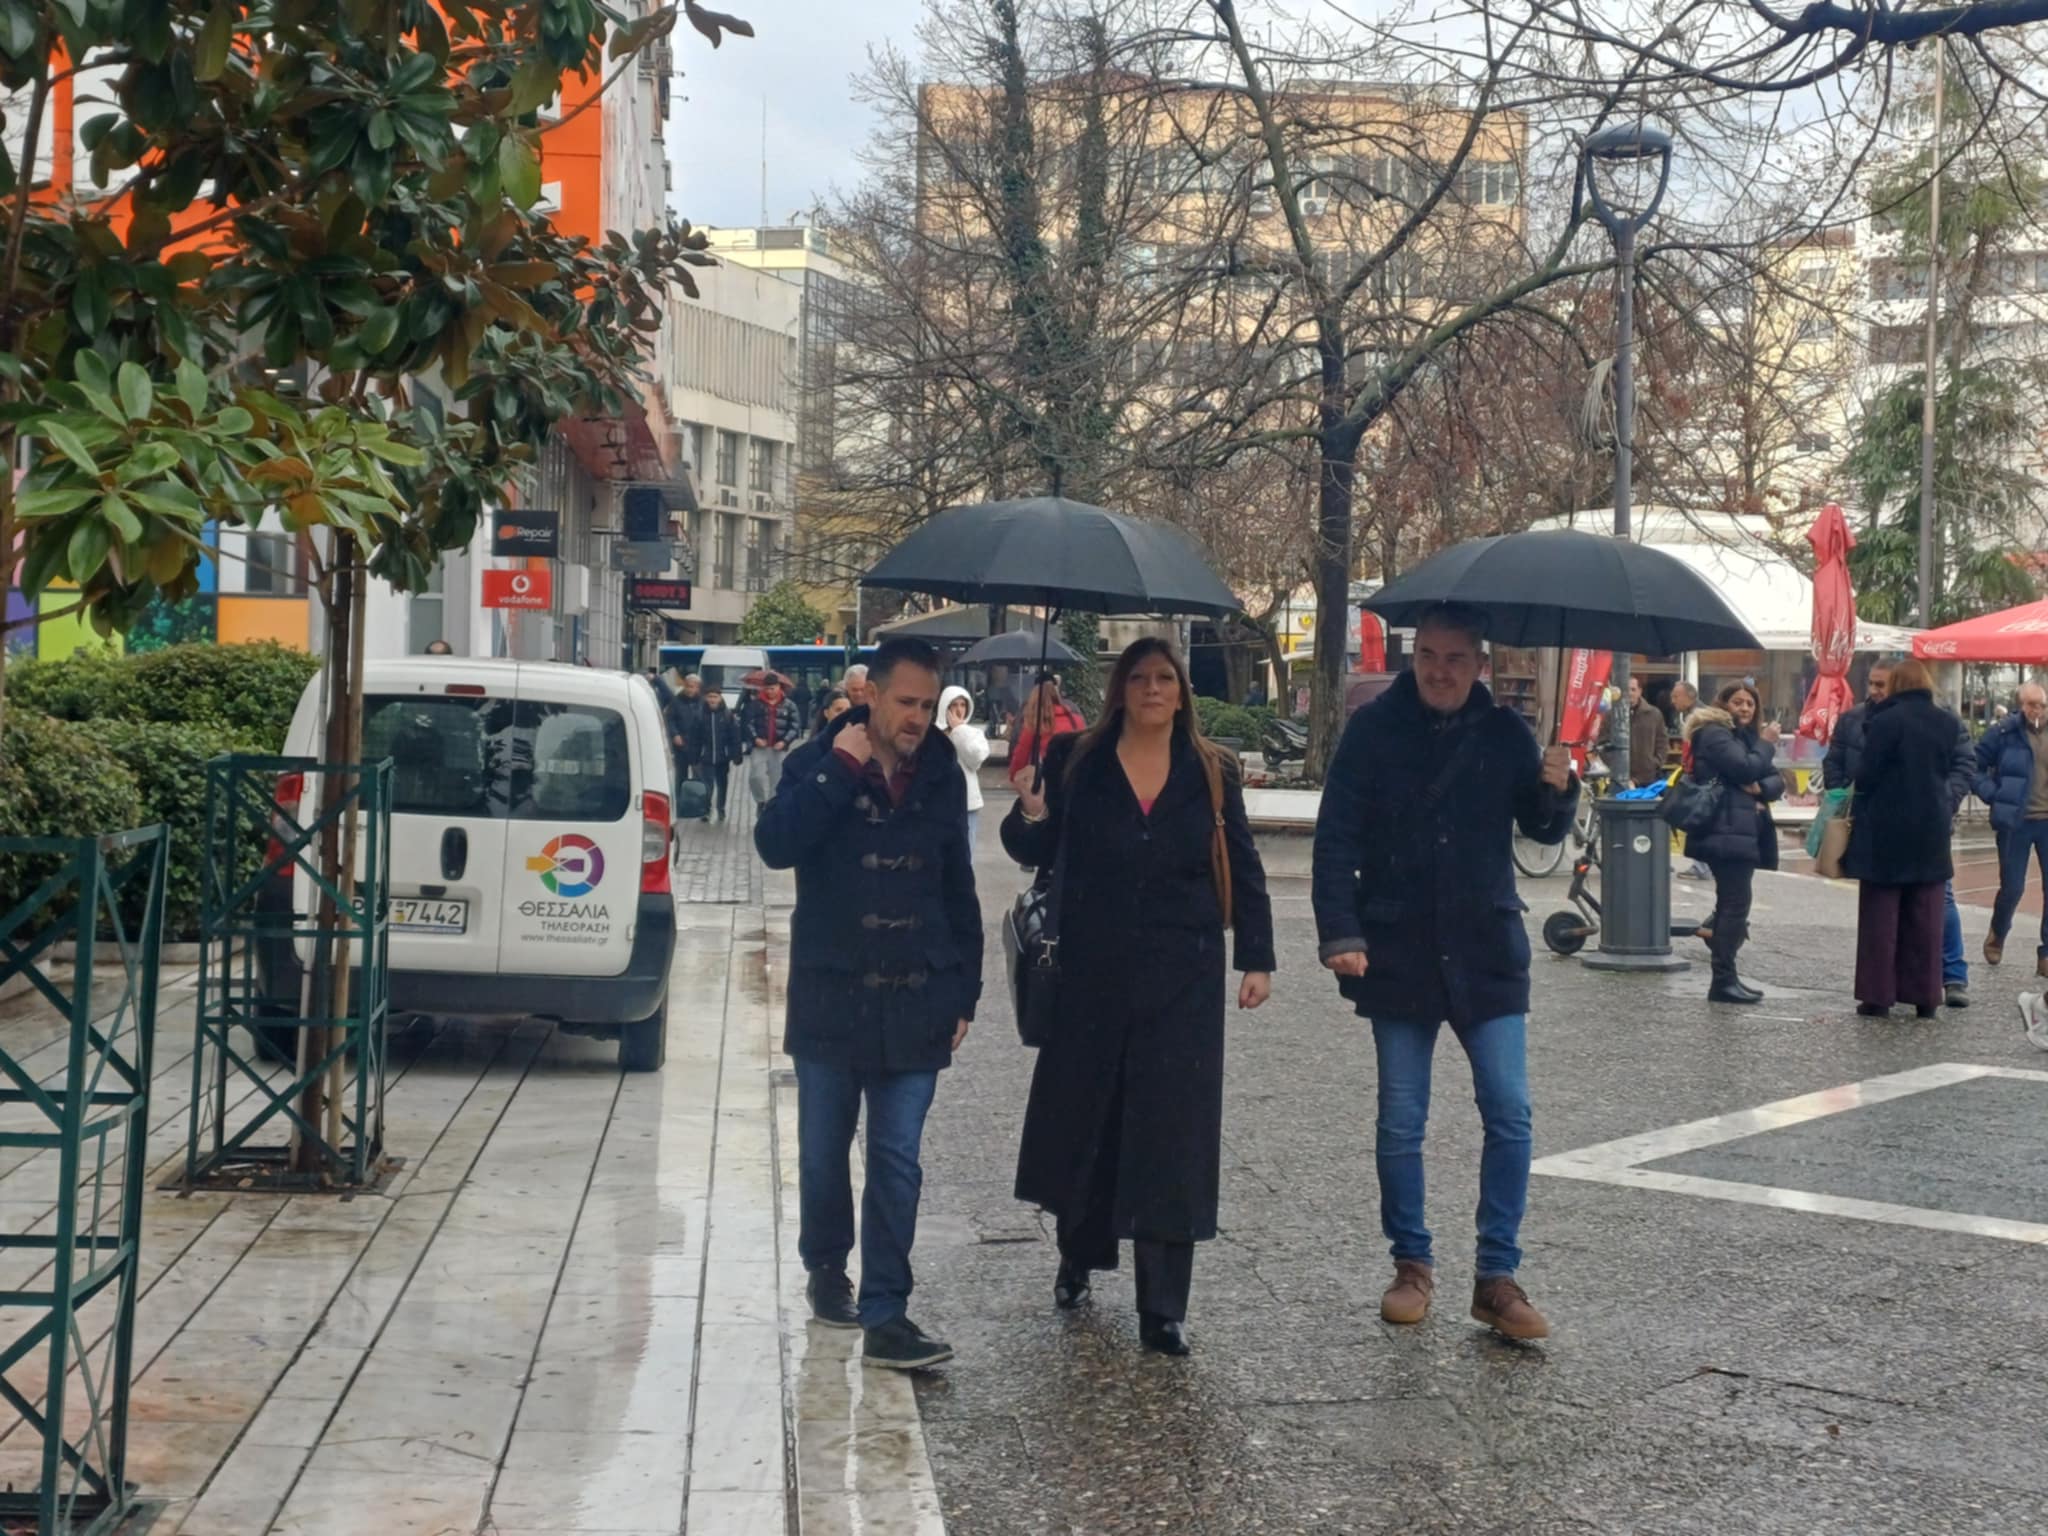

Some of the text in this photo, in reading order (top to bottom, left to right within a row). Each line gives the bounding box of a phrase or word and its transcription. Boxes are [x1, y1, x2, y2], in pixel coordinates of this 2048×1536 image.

[498, 595, 544, 605] vodafone
[518, 900, 610, 919] ΘΕΣΣΑΛΙΑ
[541, 920, 610, 933] ΤΗΛΕΟΡΑΣΗ
